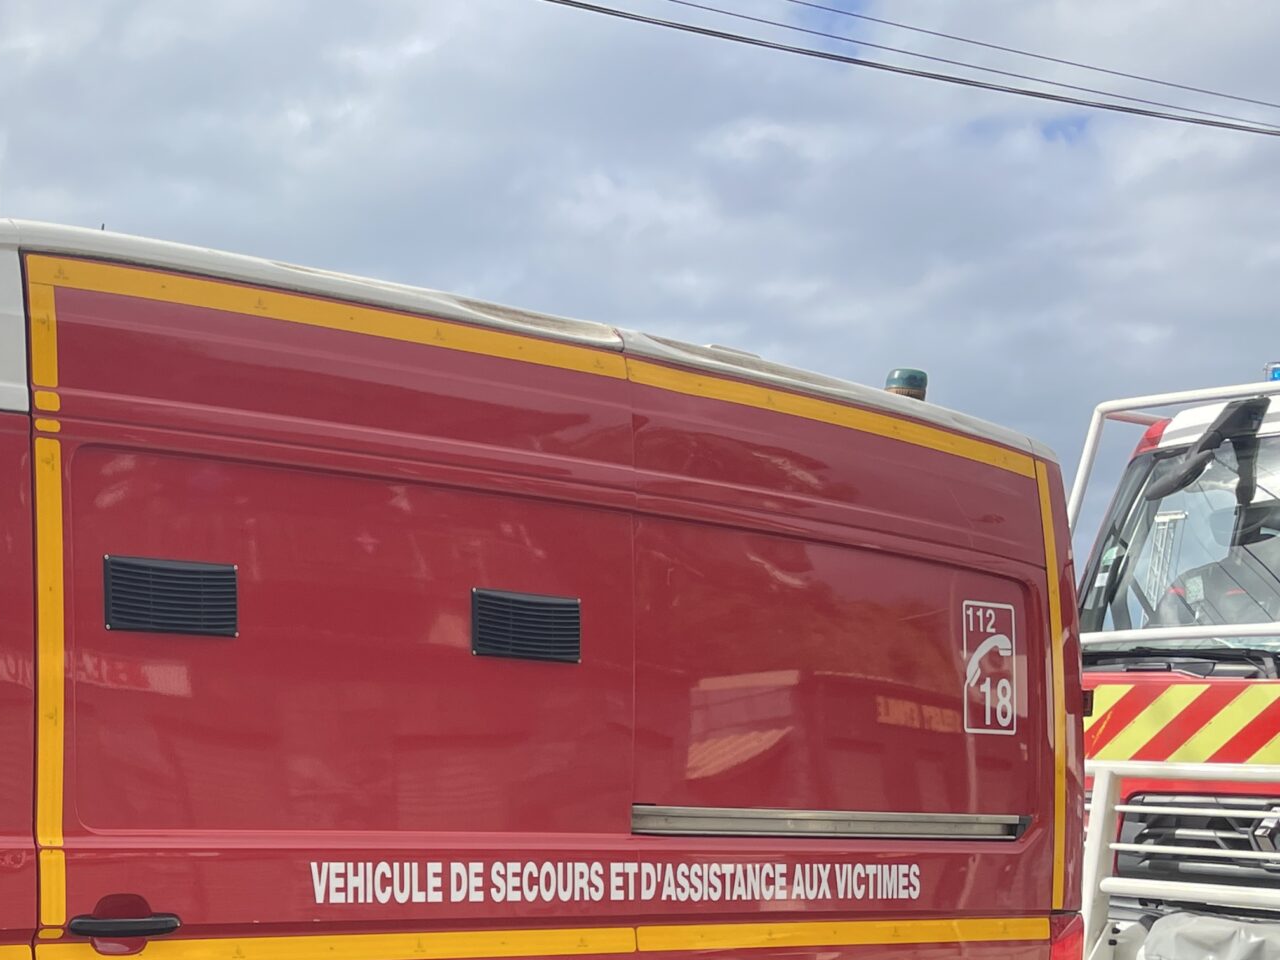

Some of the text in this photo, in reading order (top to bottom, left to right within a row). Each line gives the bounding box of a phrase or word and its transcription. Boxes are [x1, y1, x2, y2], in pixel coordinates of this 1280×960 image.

[966, 607, 996, 633] 112
[980, 677, 1012, 727] 18
[310, 861, 920, 904] VEHICULE DE SECOURS ET D'ASSISTANCE AUX VICTIMES
